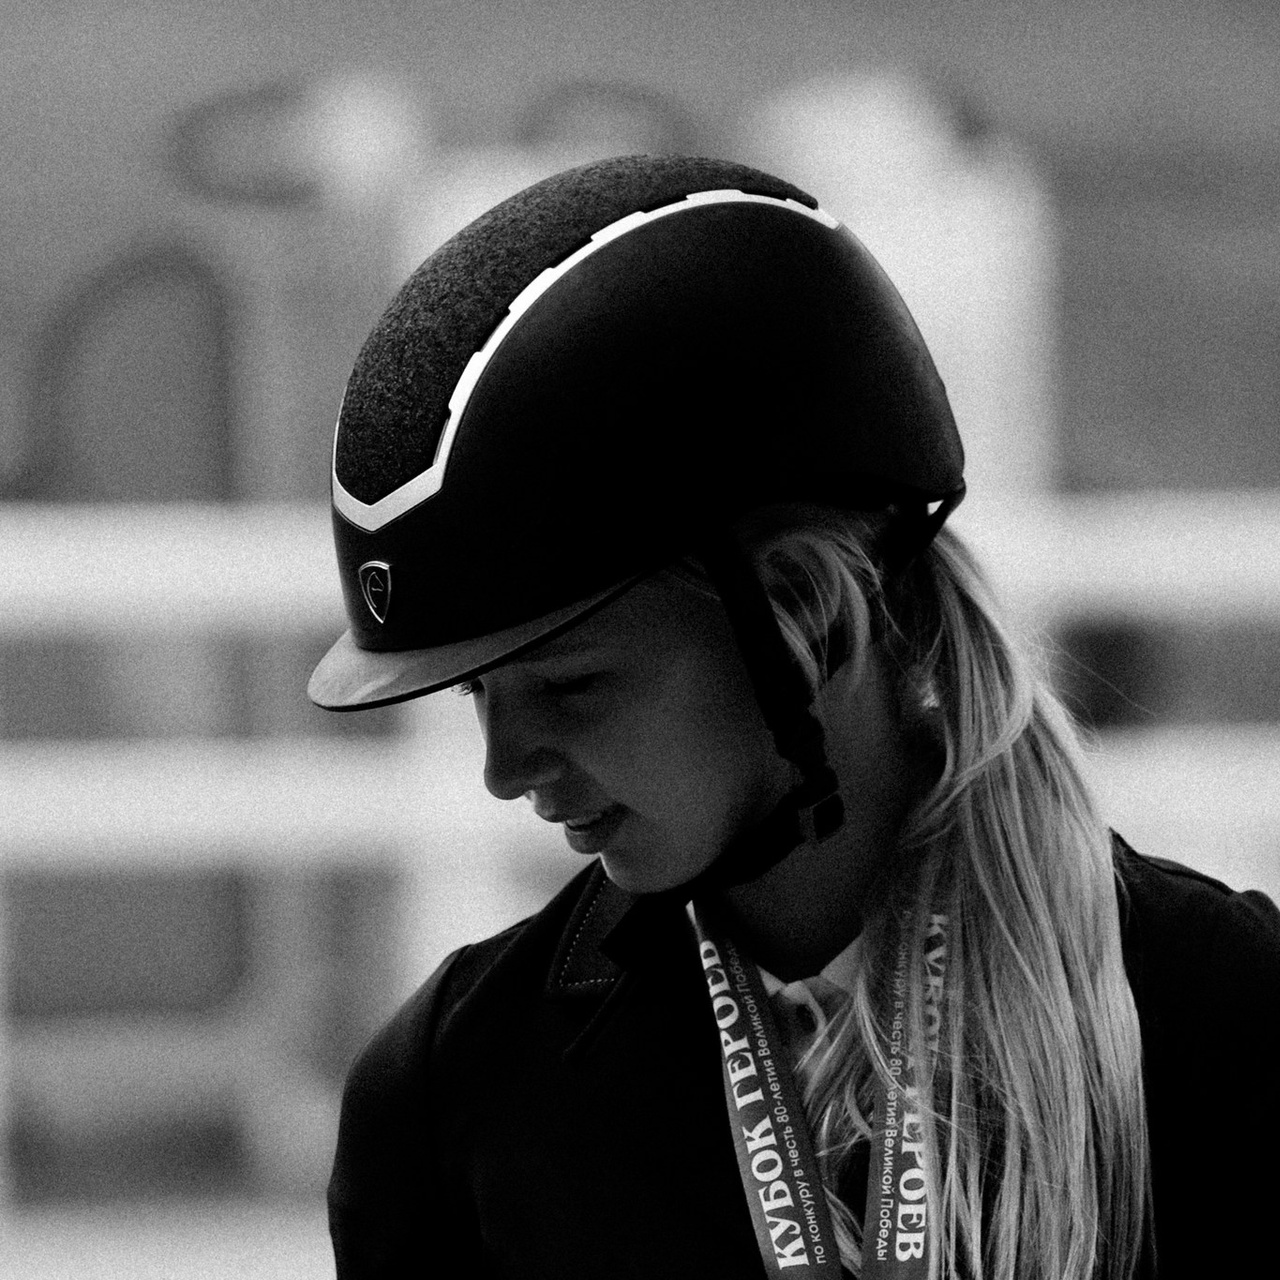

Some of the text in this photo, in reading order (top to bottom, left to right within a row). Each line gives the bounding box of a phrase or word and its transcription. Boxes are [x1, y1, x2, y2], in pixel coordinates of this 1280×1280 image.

[893, 930, 911, 998] онкуру
[743, 994, 772, 1057] Великой
[763, 1058, 790, 1124] 80-летия
[885, 1058, 903, 1126] 80летия
[783, 1125, 800, 1168] честь
[793, 1168, 805, 1178] в
[881, 1129, 898, 1196] Великой
[742, 1115, 810, 1270] КУБОК
[797, 1180, 822, 1243] конкуру
[814, 1245, 827, 1265] по
[876, 1199, 894, 1262] Победы
